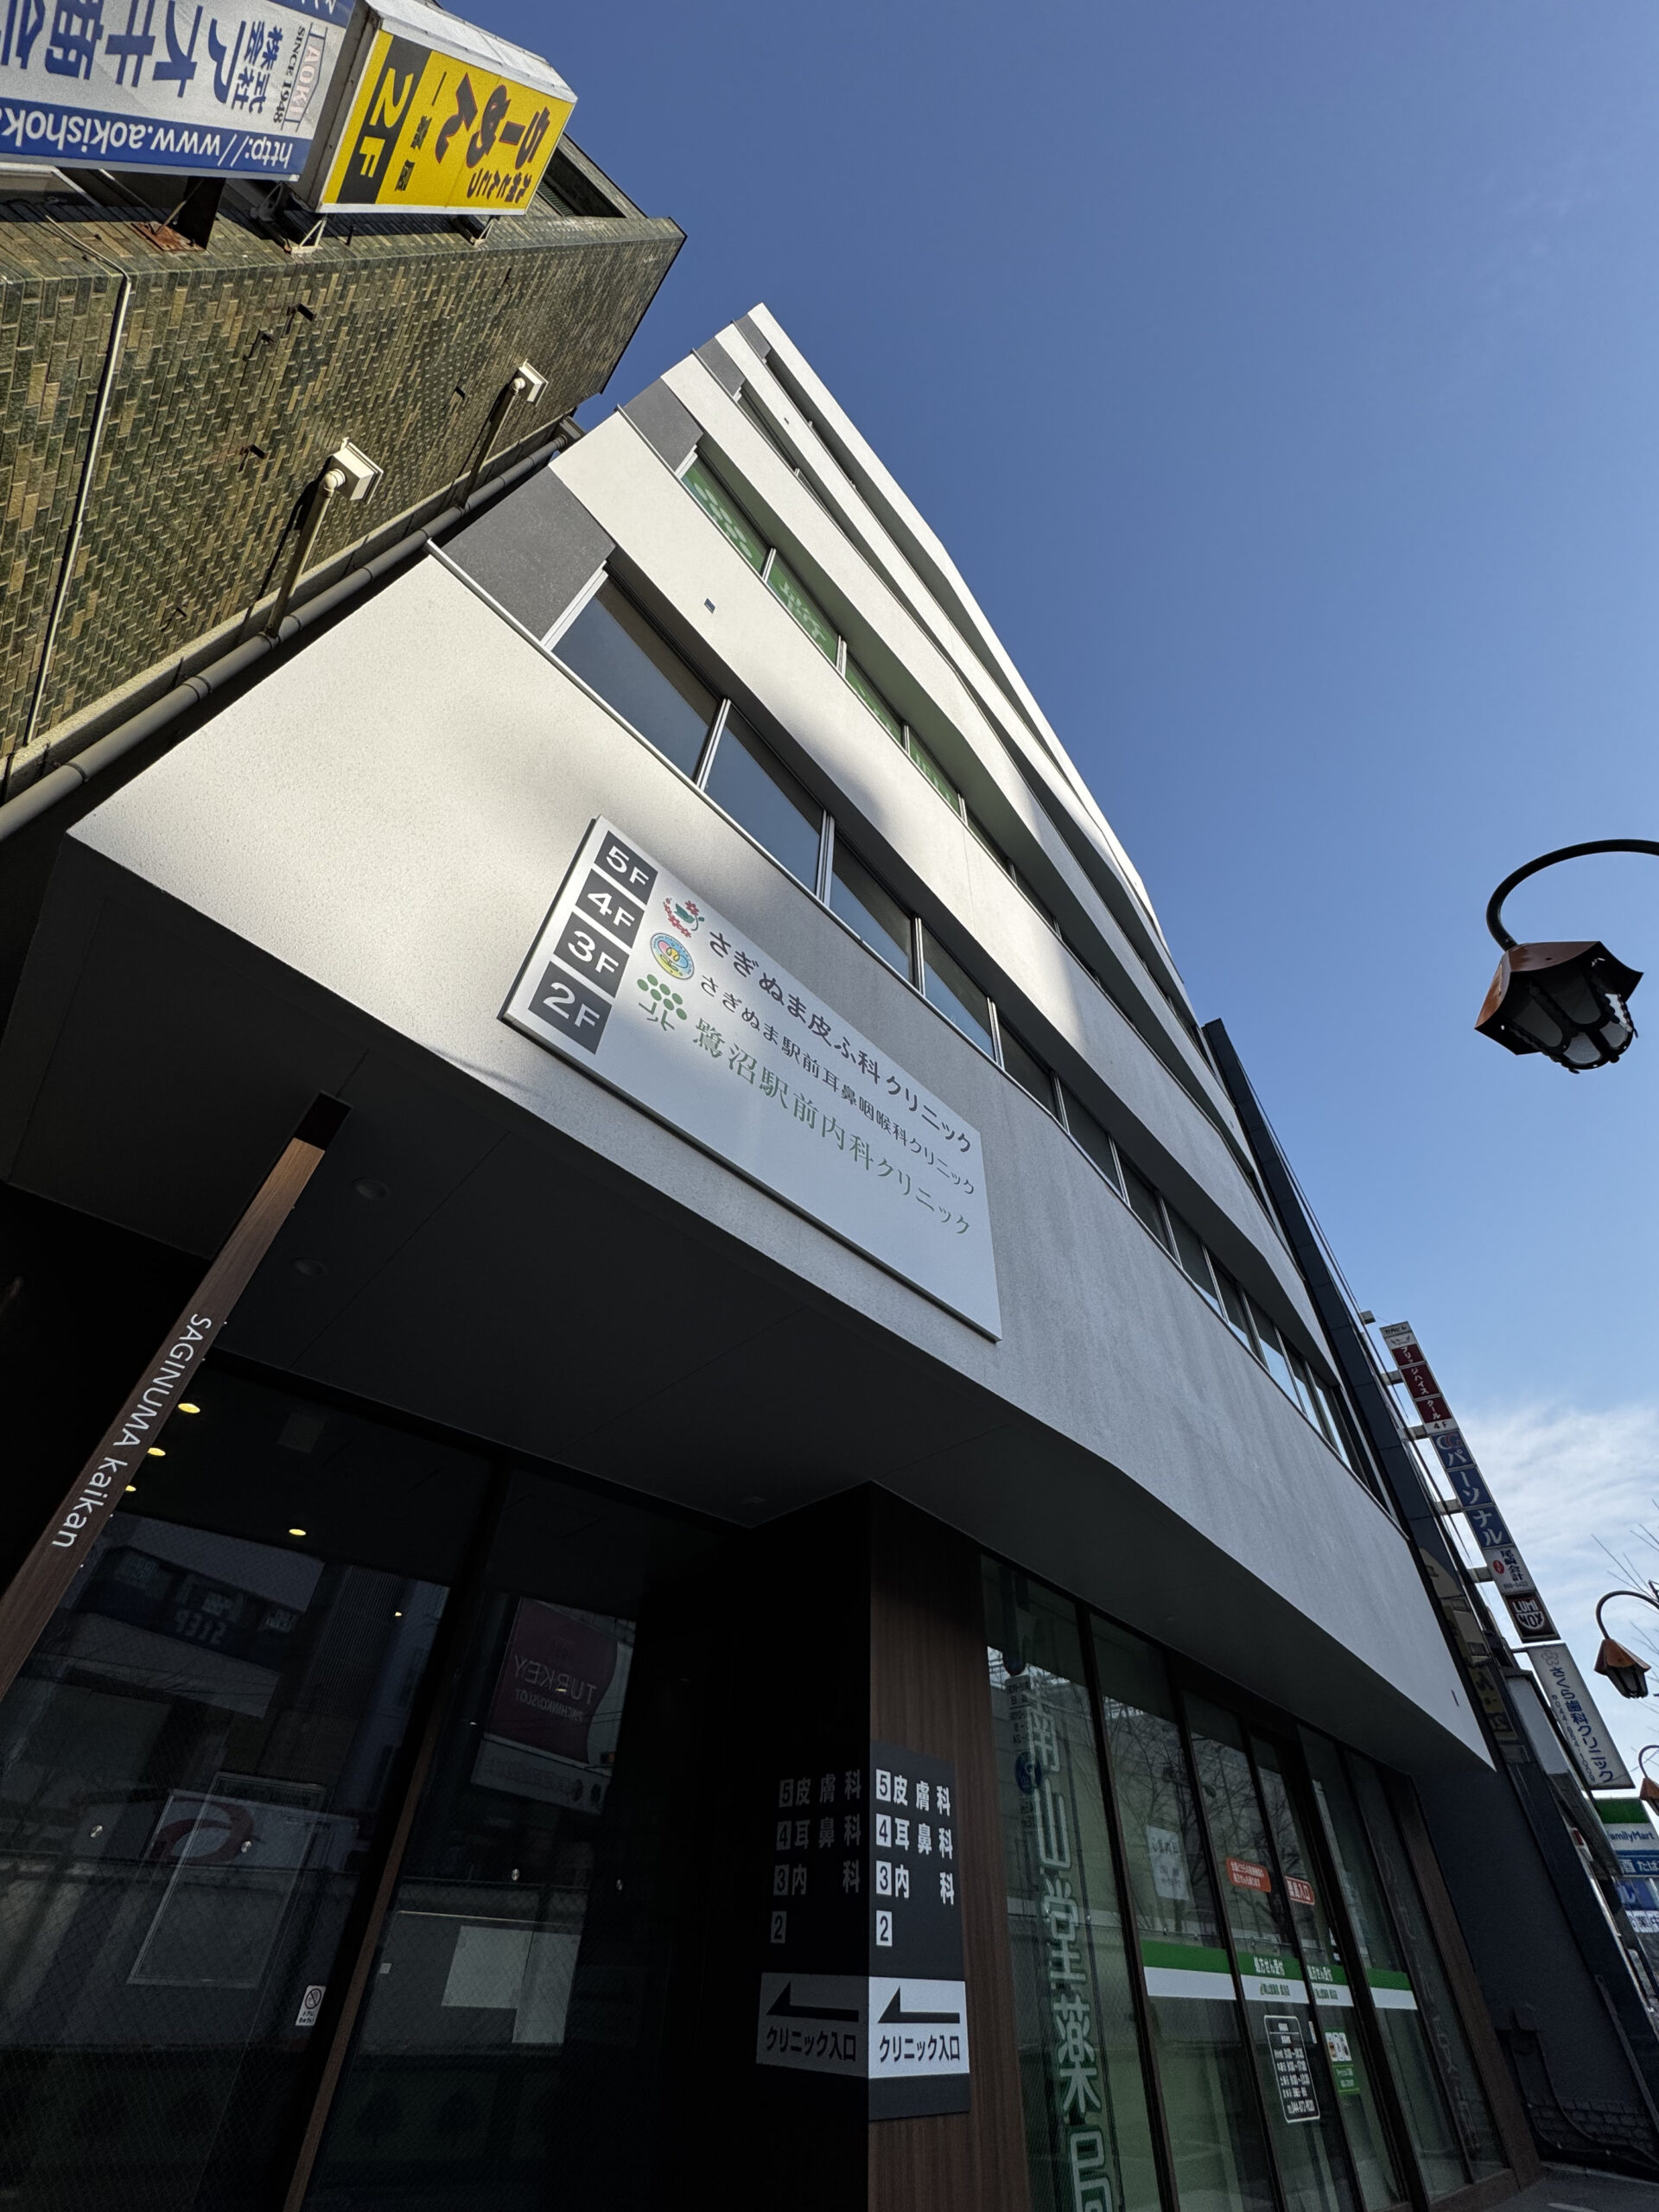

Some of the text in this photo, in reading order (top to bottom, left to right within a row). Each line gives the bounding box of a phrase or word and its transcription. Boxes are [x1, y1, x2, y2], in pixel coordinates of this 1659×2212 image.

[272, 25, 306, 124] SINCE 1948
[289, 45, 321, 114] AOKI
[0, 107, 293, 169] http://www.aokishok
[355, 67, 414, 178] 2F
[435, 72, 551, 170] らーめん
[467, 167, 533, 204] 九州とんこつ
[543, 982, 601, 1031] 2F
[606, 845, 972, 1154] 5F さぎぬま皮ふ科クリニック
[587, 892, 976, 1195] 4F さぎぬま駅前耳鼻咽喉科クリニック
[568, 930, 970, 1236] 3F 鷺沼駅前内科クリニック
[53, 1313, 212, 1548] SAGINUMA kaikan
[1447, 1448, 1503, 1546] パーソナル
[1550, 1667, 1613, 1783] さくら歯科クリニック
[893, 1775, 950, 1816] 皮膚科
[894, 1819, 952, 1859] 耳鼻科
[1608, 1831, 1655, 1842] amilyMart
[1637, 1859, 1659, 1872] たば
[894, 1865, 955, 1904] 内科
[1023, 1681, 1114, 2212] 南山堂薬局
[766, 2027, 857, 2063] クリニック入口
[879, 2034, 961, 2063] クリニック入口
